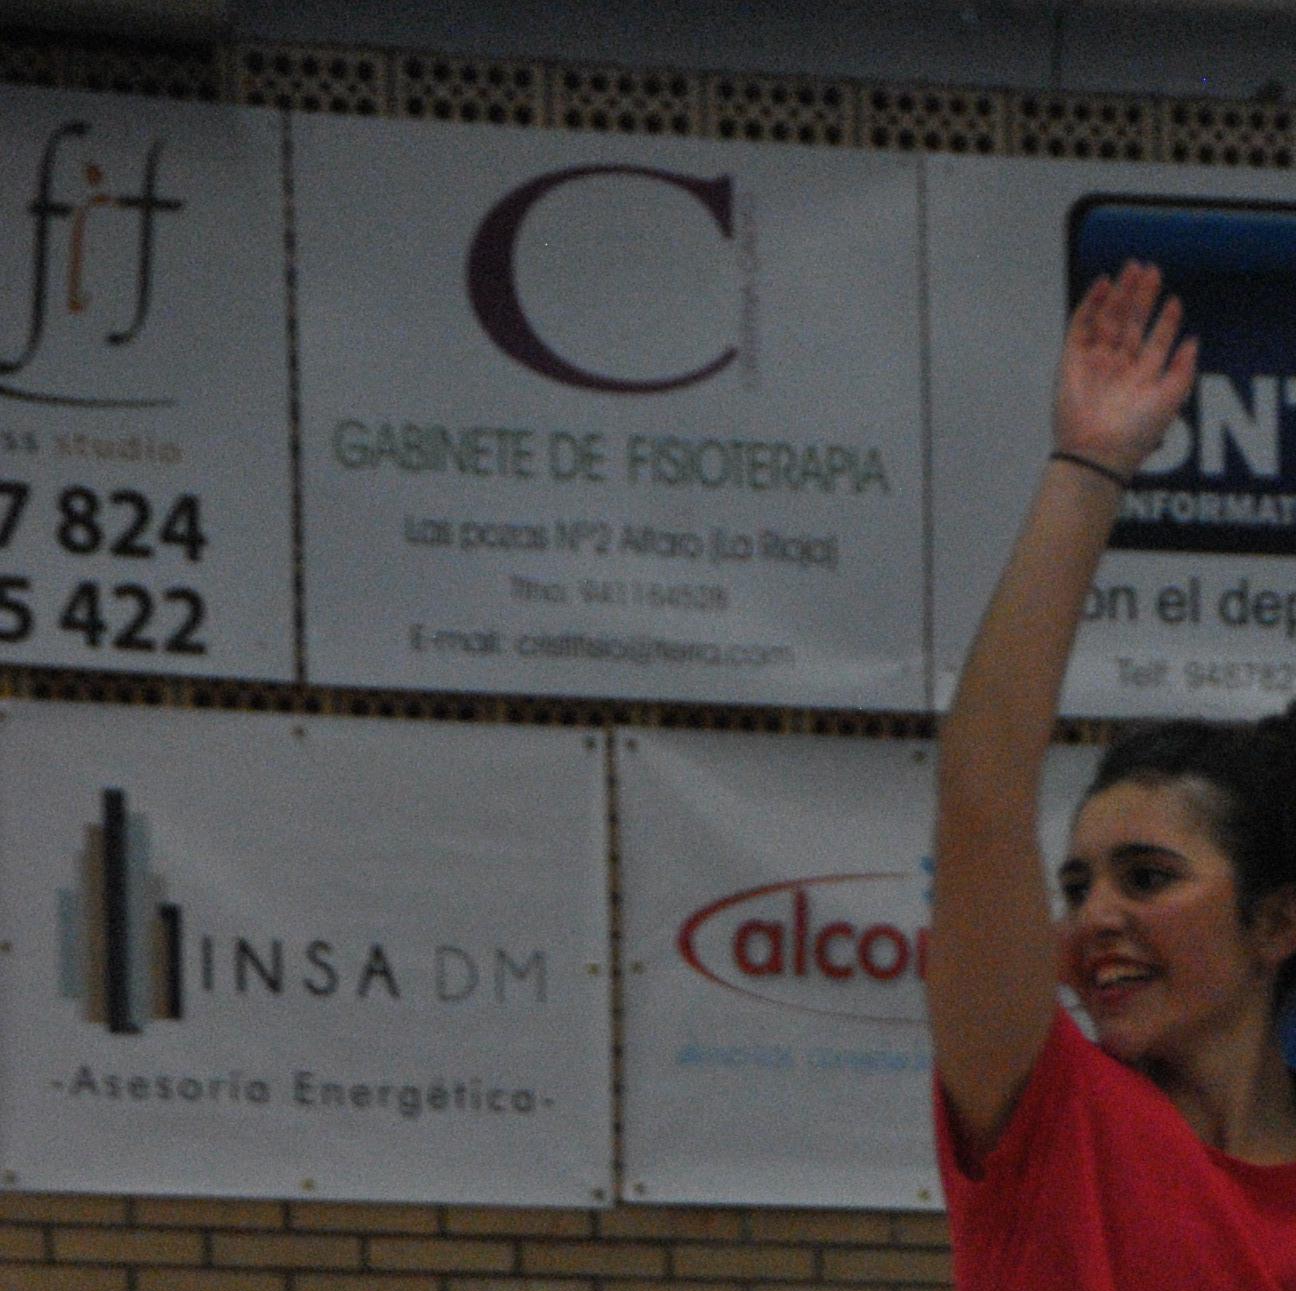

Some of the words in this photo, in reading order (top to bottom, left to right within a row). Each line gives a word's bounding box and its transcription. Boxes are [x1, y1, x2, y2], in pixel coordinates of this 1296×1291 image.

[329, 416, 537, 480] GABINETE
[547, 428, 607, 483] DE
[625, 433, 893, 496] FISIOTERAPIA
[54, 482, 211, 565] 824
[56, 577, 210, 657] 422
[1083, 584, 1139, 622] on
[1155, 577, 1202, 624] el
[202, 934, 402, 999] INSA
[433, 943, 548, 1003] DM
[732, 888, 930, 982] alco
